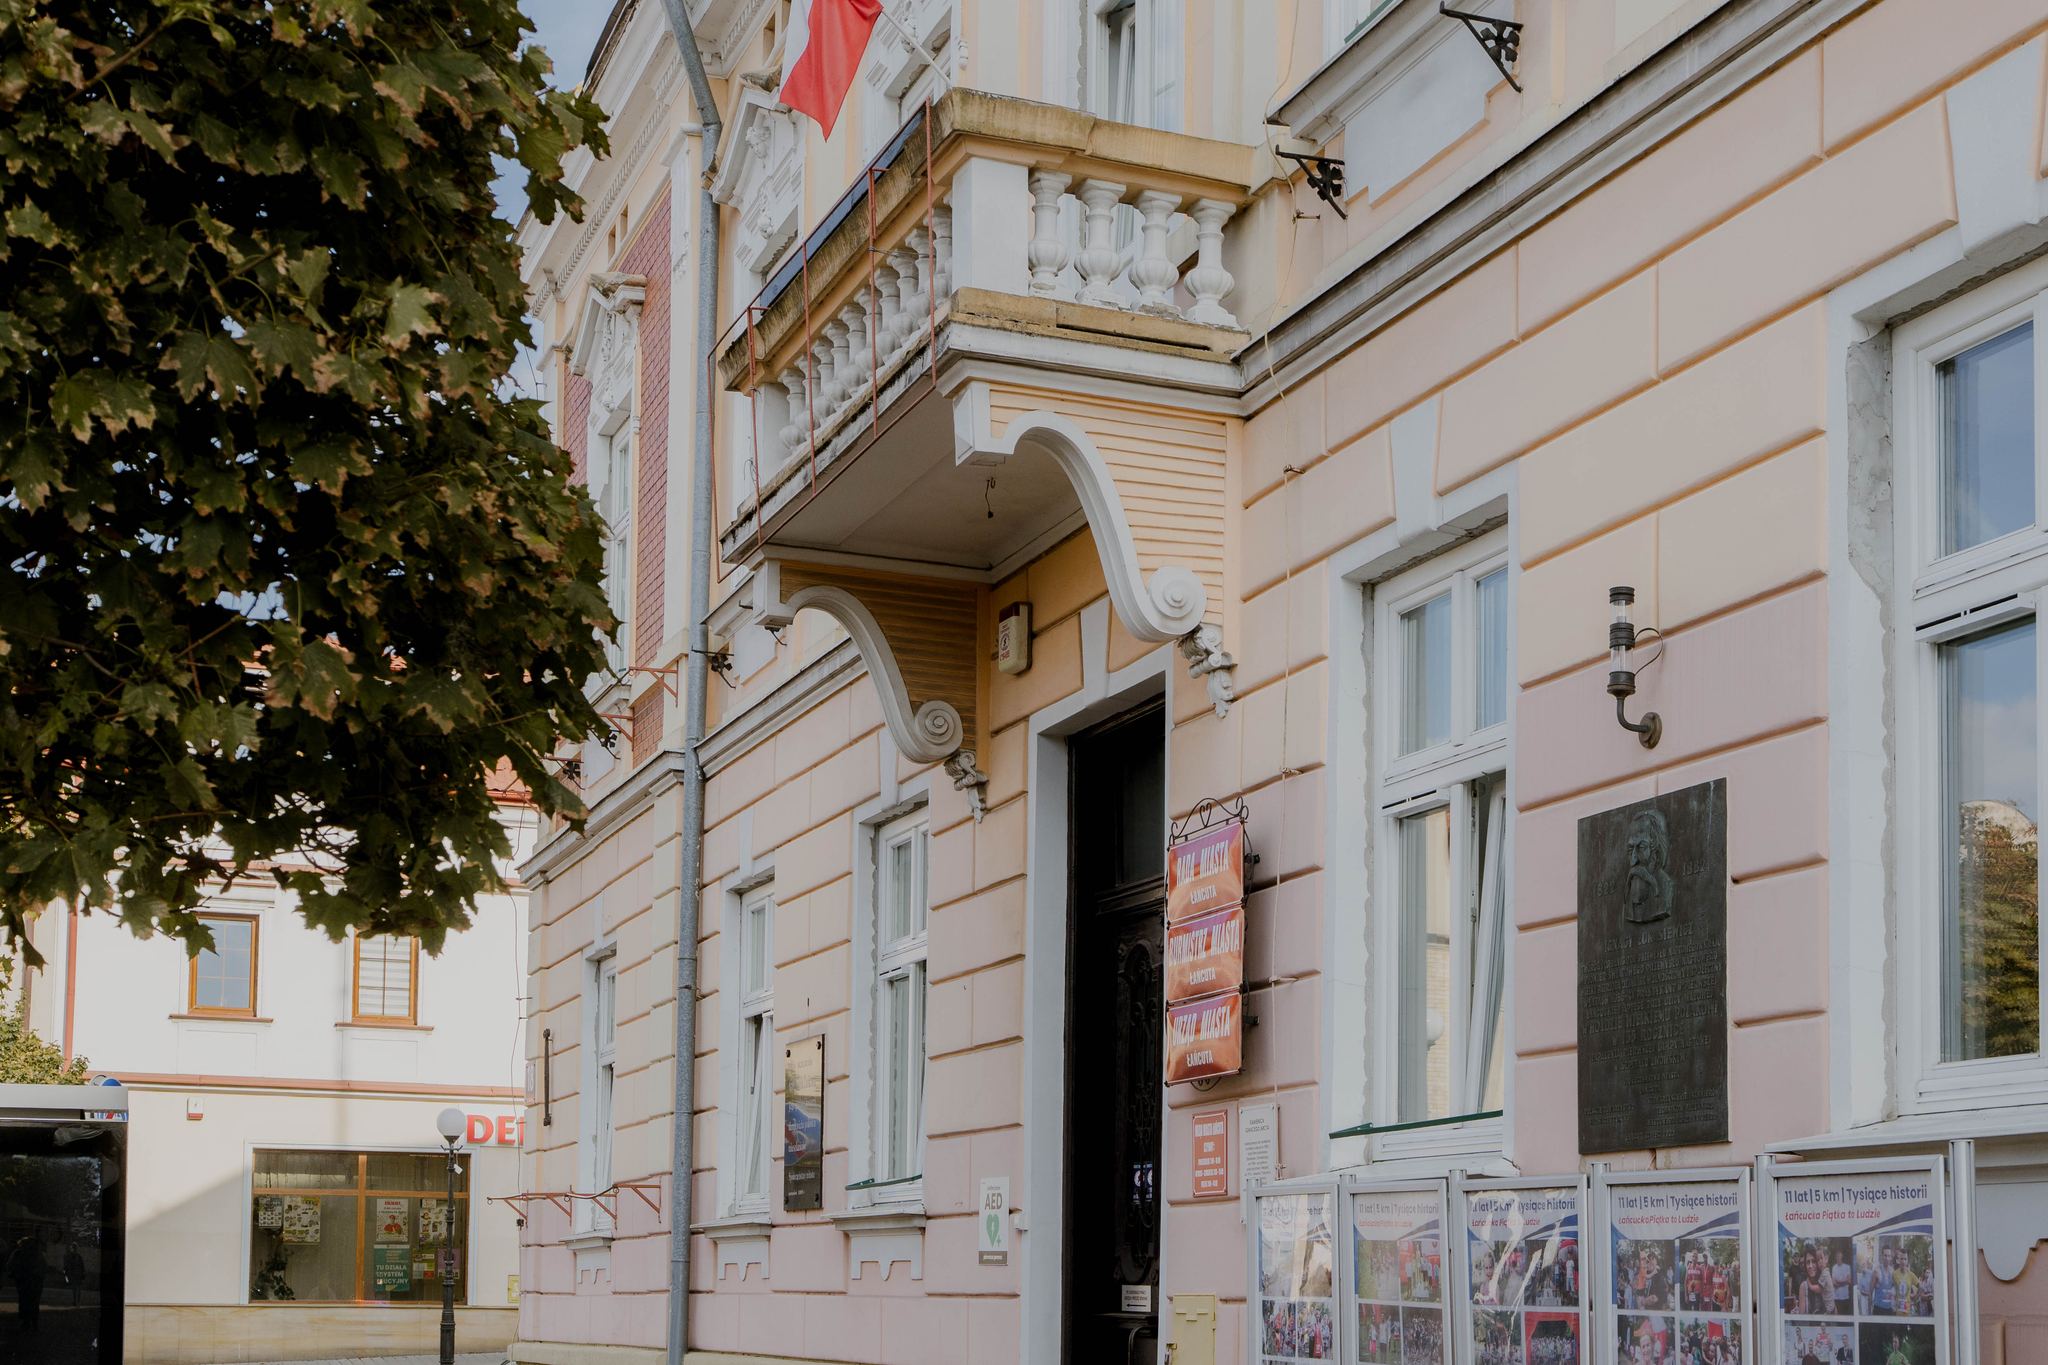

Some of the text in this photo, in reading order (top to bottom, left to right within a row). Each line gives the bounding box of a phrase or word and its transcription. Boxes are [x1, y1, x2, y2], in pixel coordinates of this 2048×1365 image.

[1176, 839, 1229, 888] RADA MIASTA
[1169, 919, 1240, 967] BURMISTRZ MIASTA
[1189, 967, 1216, 985] ŁAŃCUTA
[1173, 1005, 1230, 1046] URZĄD MIASTA
[1186, 1049, 1213, 1067] ŁAŃCUTA
[466, 1114, 525, 1146] DE
[984, 1192, 1003, 1210] AED
[1626, 1196, 1638, 1209] lat
[1643, 1196, 1649, 1208] 5
[1650, 1195, 1665, 1208] km
[1670, 1194, 1705, 1211] Tysiące
[1706, 1192, 1738, 1206] historii
[1794, 1189, 1808, 1203] lat
[1814, 1189, 1821, 1202] 5
[1823, 1188, 1840, 1202] km
[1846, 1187, 1887, 1205] Tysiące
[1889, 1184, 1927, 1200] historii
[1546, 1198, 1576, 1211] historii
[1649, 1215, 1670, 1226] Piątka
[1678, 1215, 1700, 1224] Ludzie
[1821, 1209, 1846, 1222] Piątka
[1856, 1210, 1881, 1219] Ludzie
